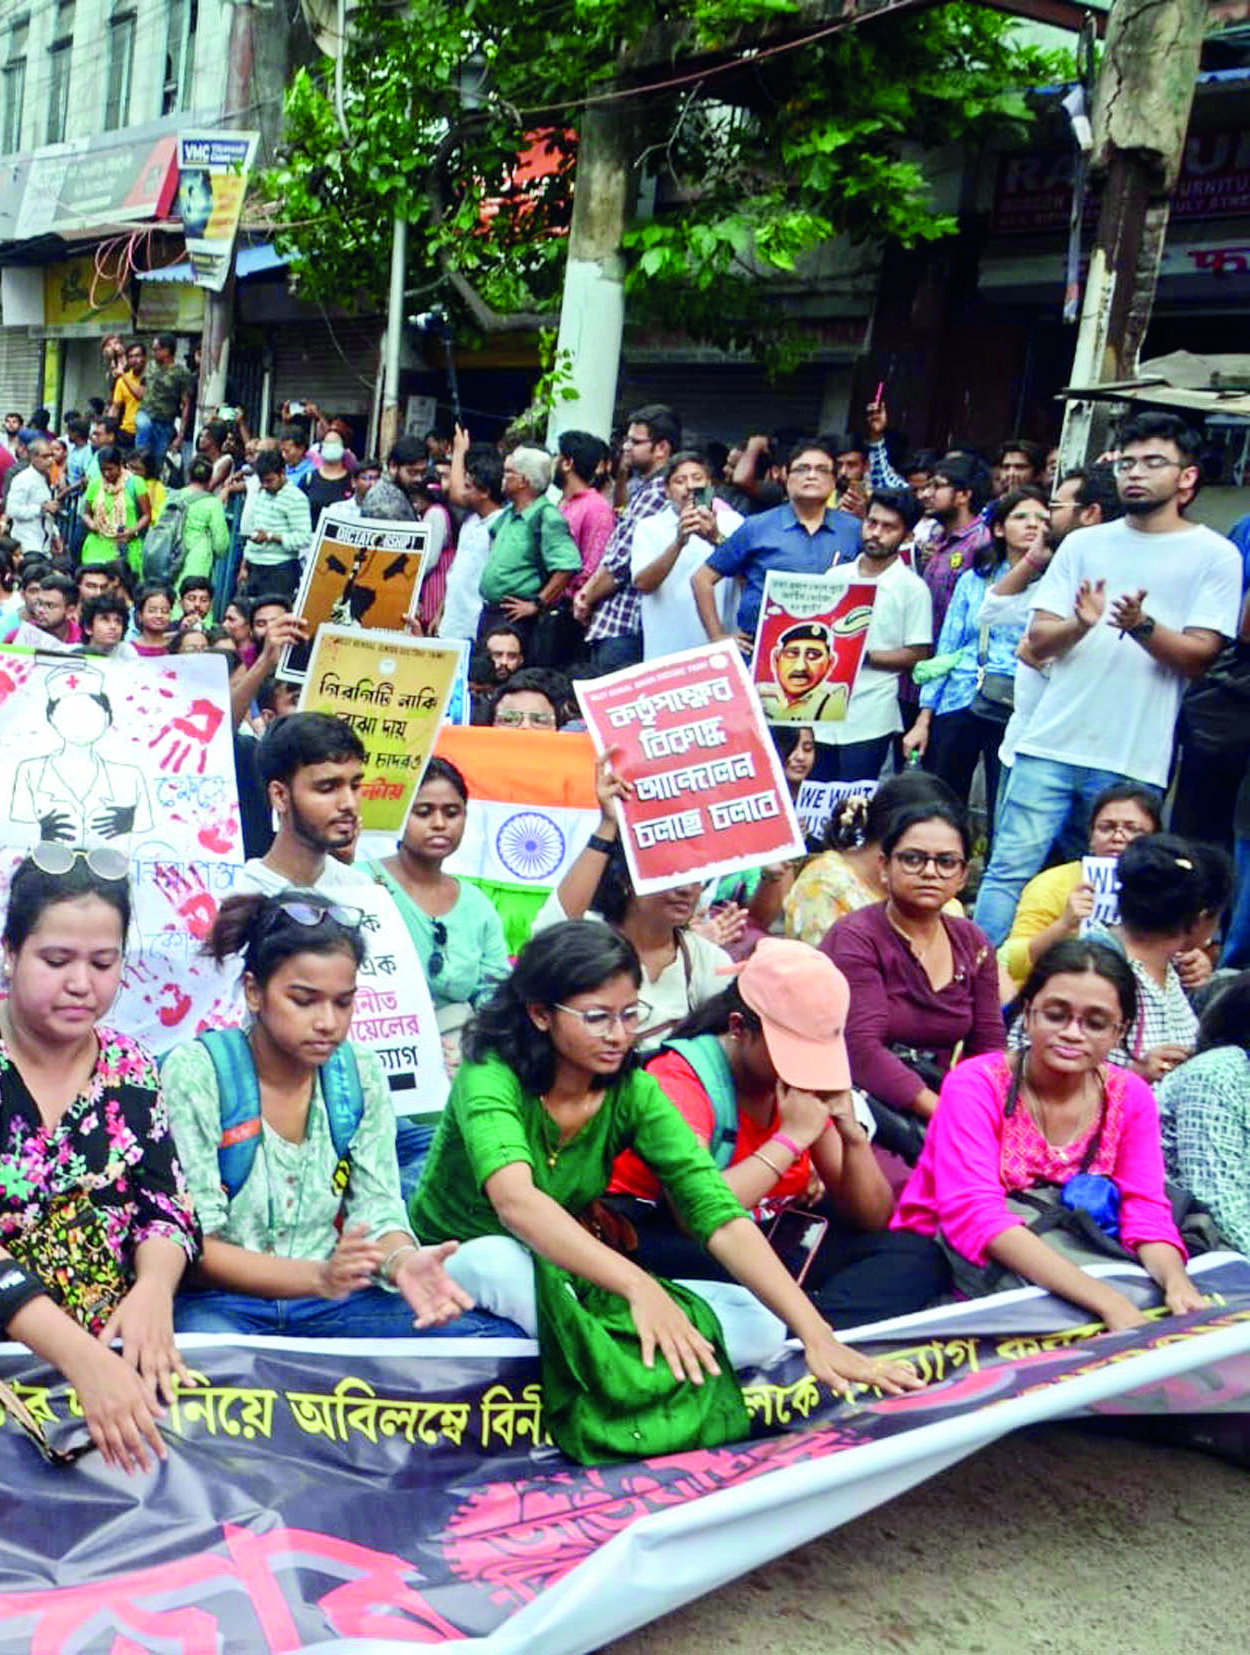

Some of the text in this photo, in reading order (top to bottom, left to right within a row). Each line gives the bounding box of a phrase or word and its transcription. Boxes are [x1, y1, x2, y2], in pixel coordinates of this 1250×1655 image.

[319, 672, 438, 711] গিরগিটি নাকি
[639, 715, 729, 760] বিরুদ্ধে
[634, 751, 756, 801] আন্দোলন
[799, 787, 826, 808] WE
[632, 808, 706, 849] চলছে
[708, 789, 780, 831] চলবে
[286, 1376, 469, 1447] অবিলম্বে
[480, 1384, 556, 1450] বিনী
